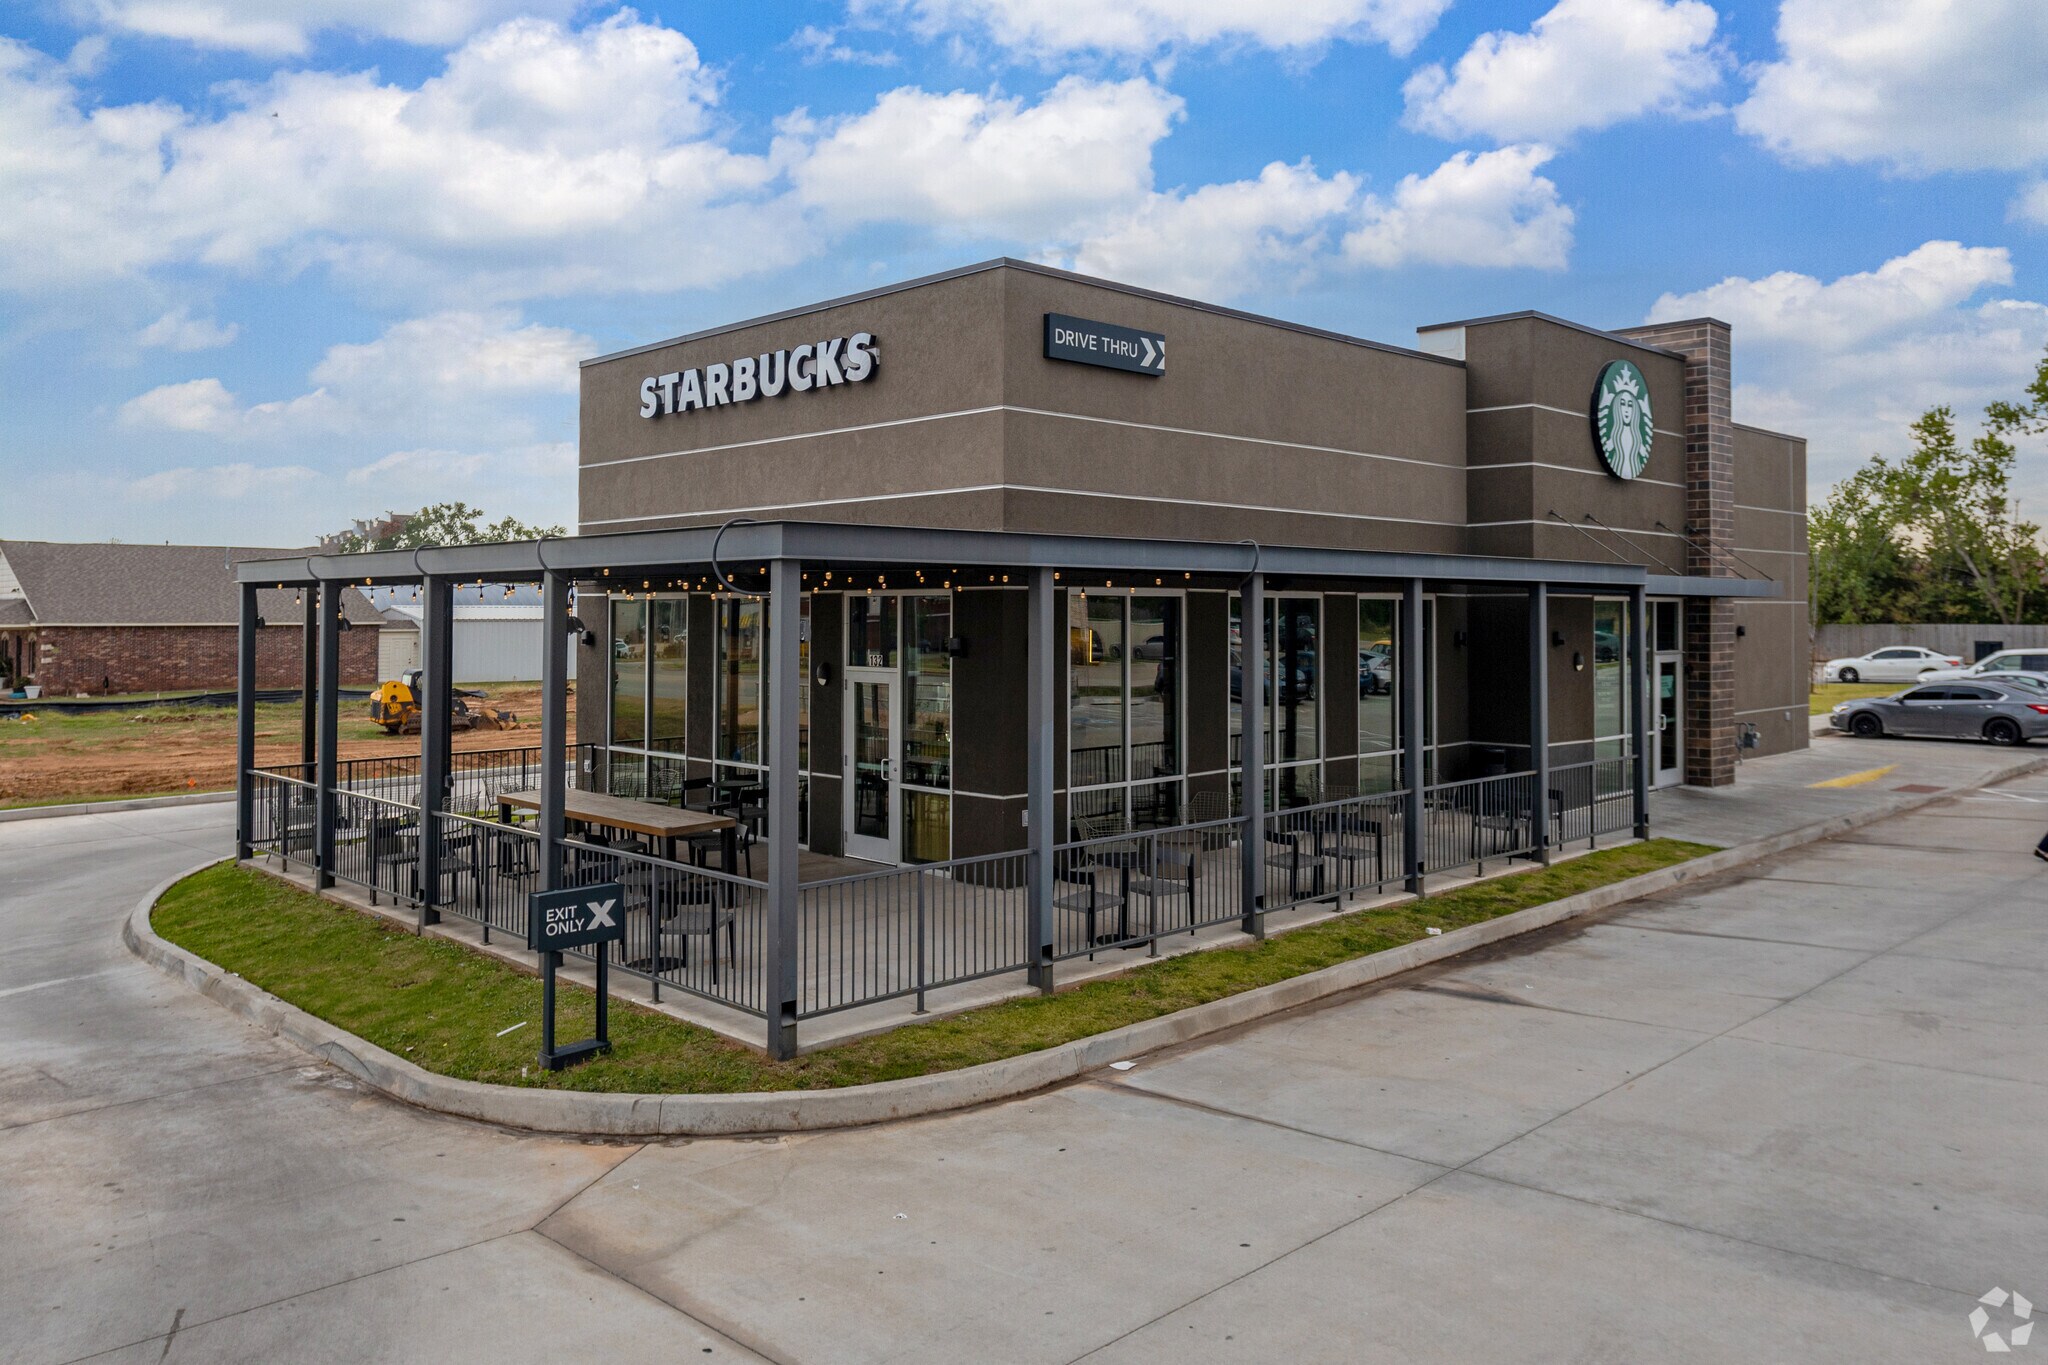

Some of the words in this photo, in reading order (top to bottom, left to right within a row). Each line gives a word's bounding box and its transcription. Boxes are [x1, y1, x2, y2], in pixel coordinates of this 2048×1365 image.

[1055, 328, 1098, 351] DRIVE
[1102, 336, 1138, 358] THRU
[639, 332, 876, 419] STARBUCKS
[545, 905, 578, 922] EXIT
[545, 918, 585, 937] ONLY
